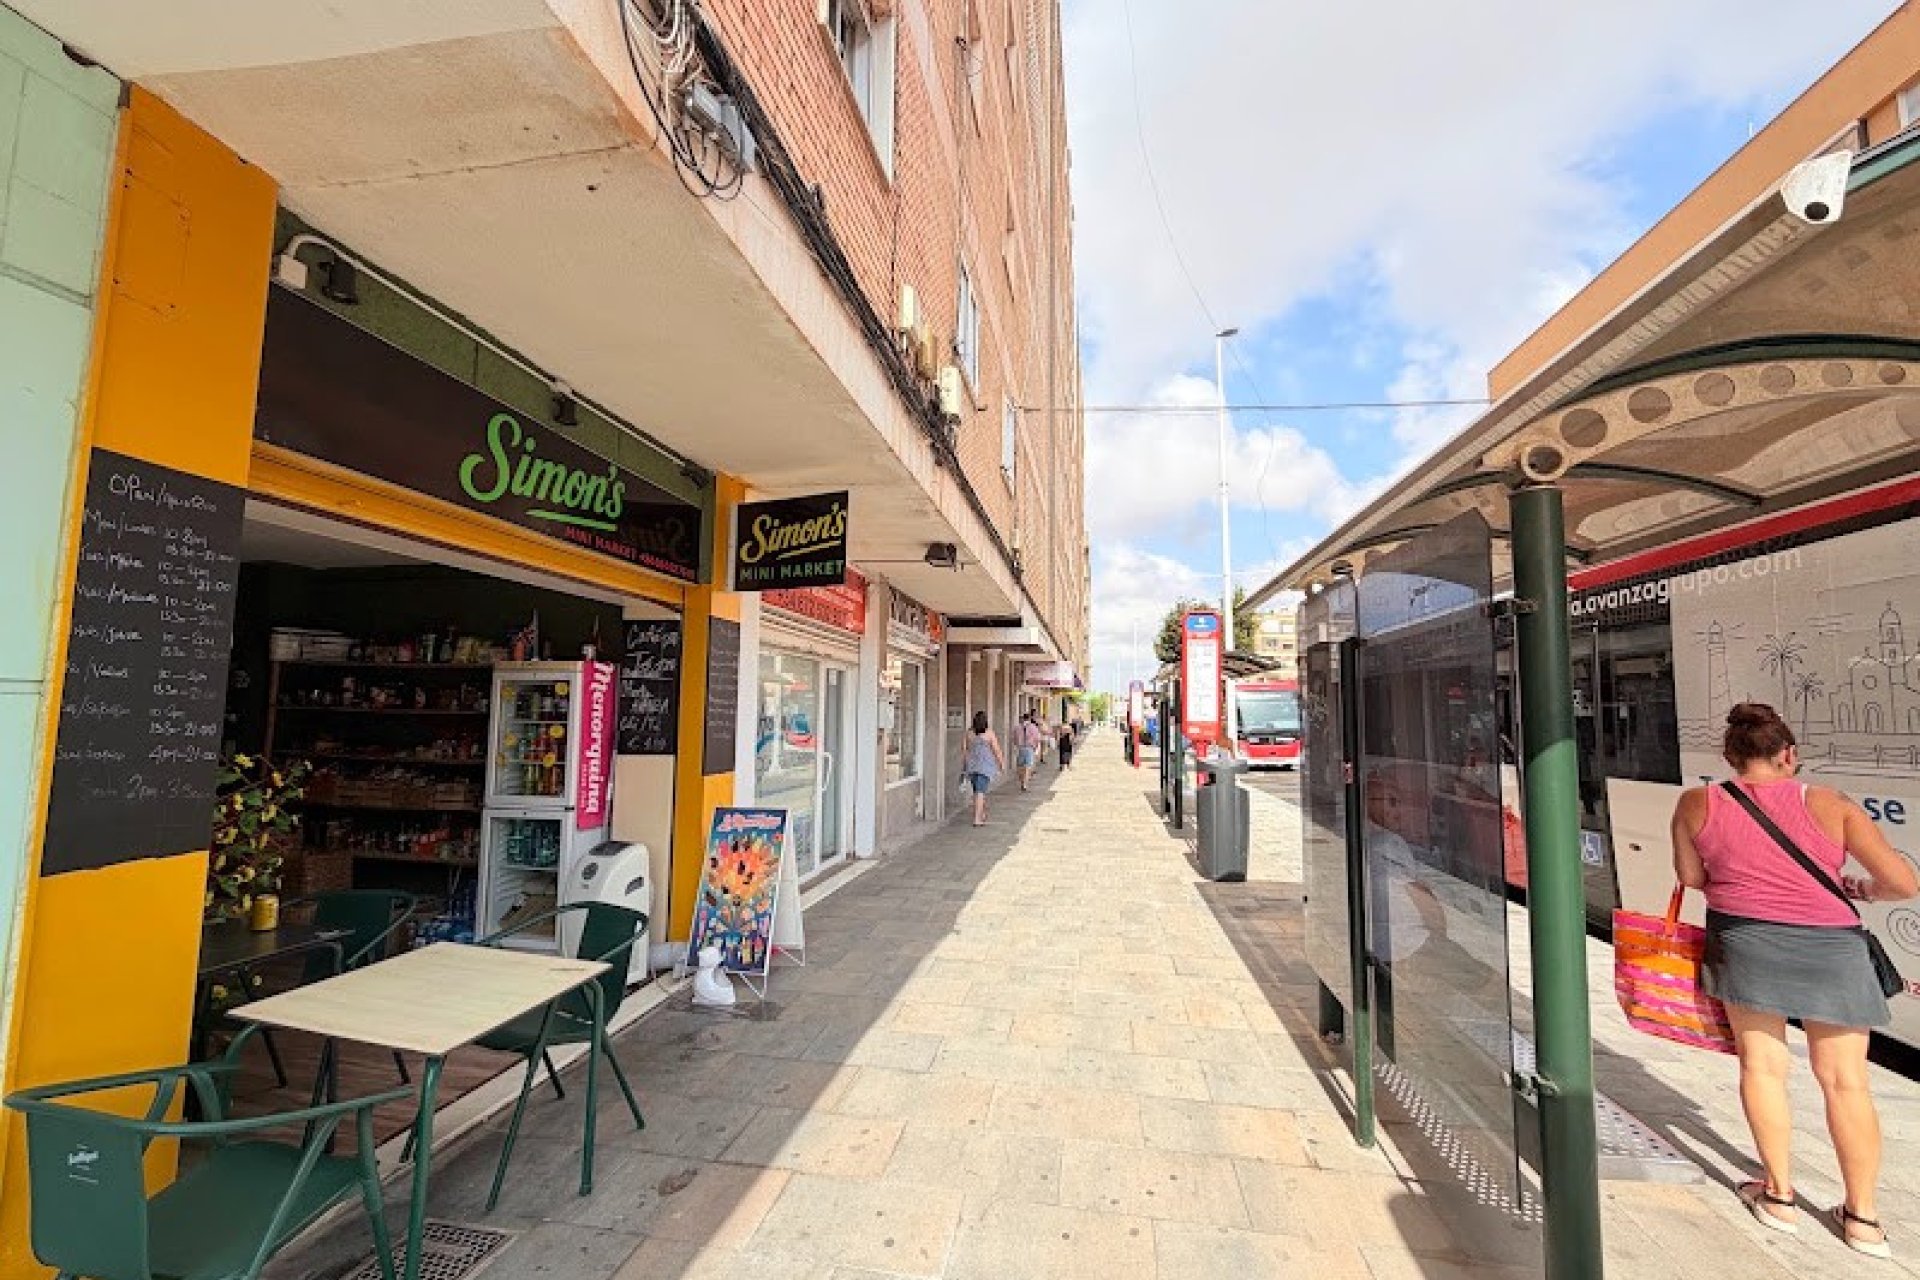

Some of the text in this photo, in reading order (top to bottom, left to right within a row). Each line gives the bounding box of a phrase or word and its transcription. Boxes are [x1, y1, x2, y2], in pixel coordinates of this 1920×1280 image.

[459, 413, 626, 518] Simon's
[565, 525, 592, 546] MINI
[739, 501, 847, 563] Simon's
[739, 559, 845, 582] MINI MARKET
[583, 661, 615, 814] Menorquina
